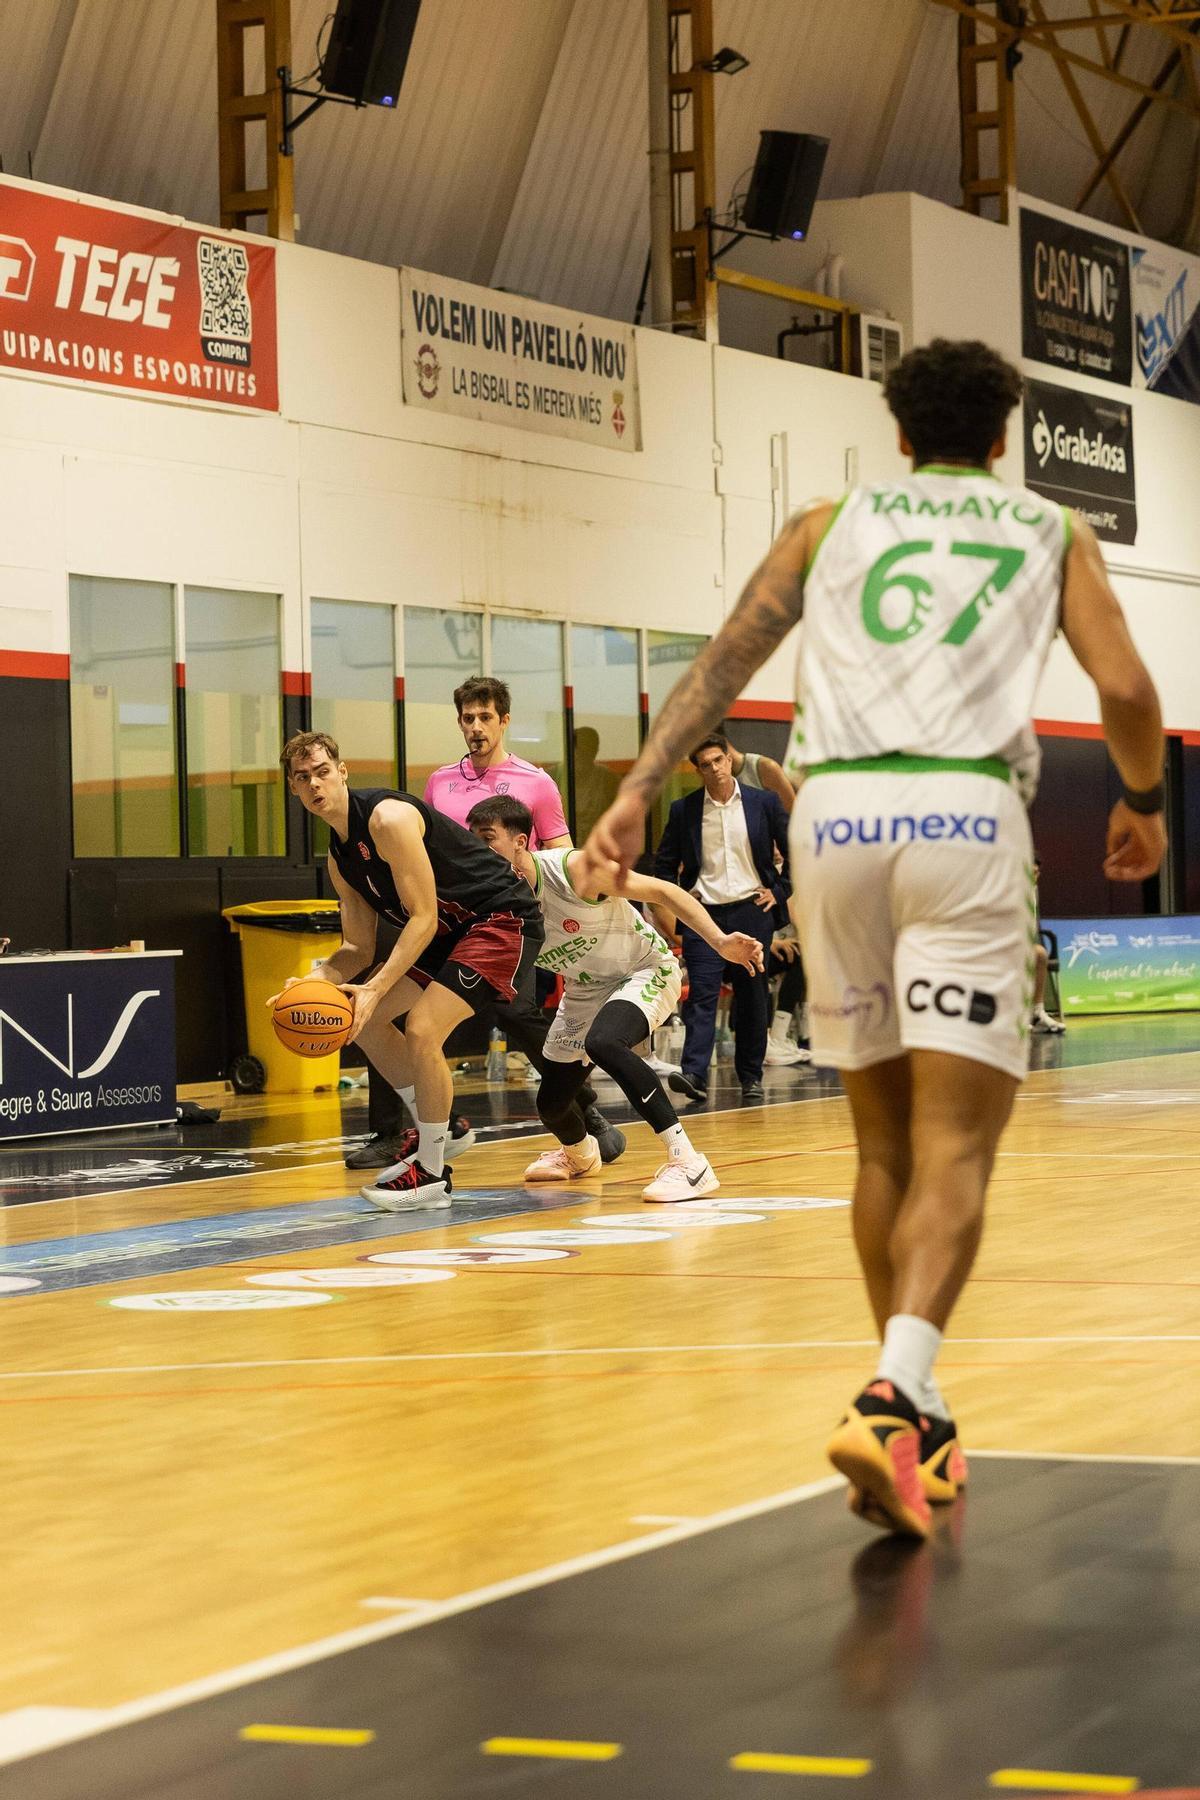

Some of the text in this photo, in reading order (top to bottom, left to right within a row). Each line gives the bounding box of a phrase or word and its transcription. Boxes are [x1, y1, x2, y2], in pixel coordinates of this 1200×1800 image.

[207, 341, 248, 362] COMPRA
[412, 289, 626, 381] VOLEM UN PAVELLÓ NOU
[133, 354, 257, 397] ESPORTIVES
[452, 366, 602, 425] LA BISBAL ES MEREIX MÉS
[1054, 424, 1127, 474] Grabalosa
[870, 491, 1044, 525] TAMAYO
[861, 540, 1026, 645] 67
[813, 813, 998, 857] younexa
[536, 936, 587, 966] AMICS
[291, 1011, 343, 1026] Wilson
[37, 1089, 47, 1113] &
[51, 1087, 92, 1112] Saura
[96, 1084, 162, 1107] Assessors
